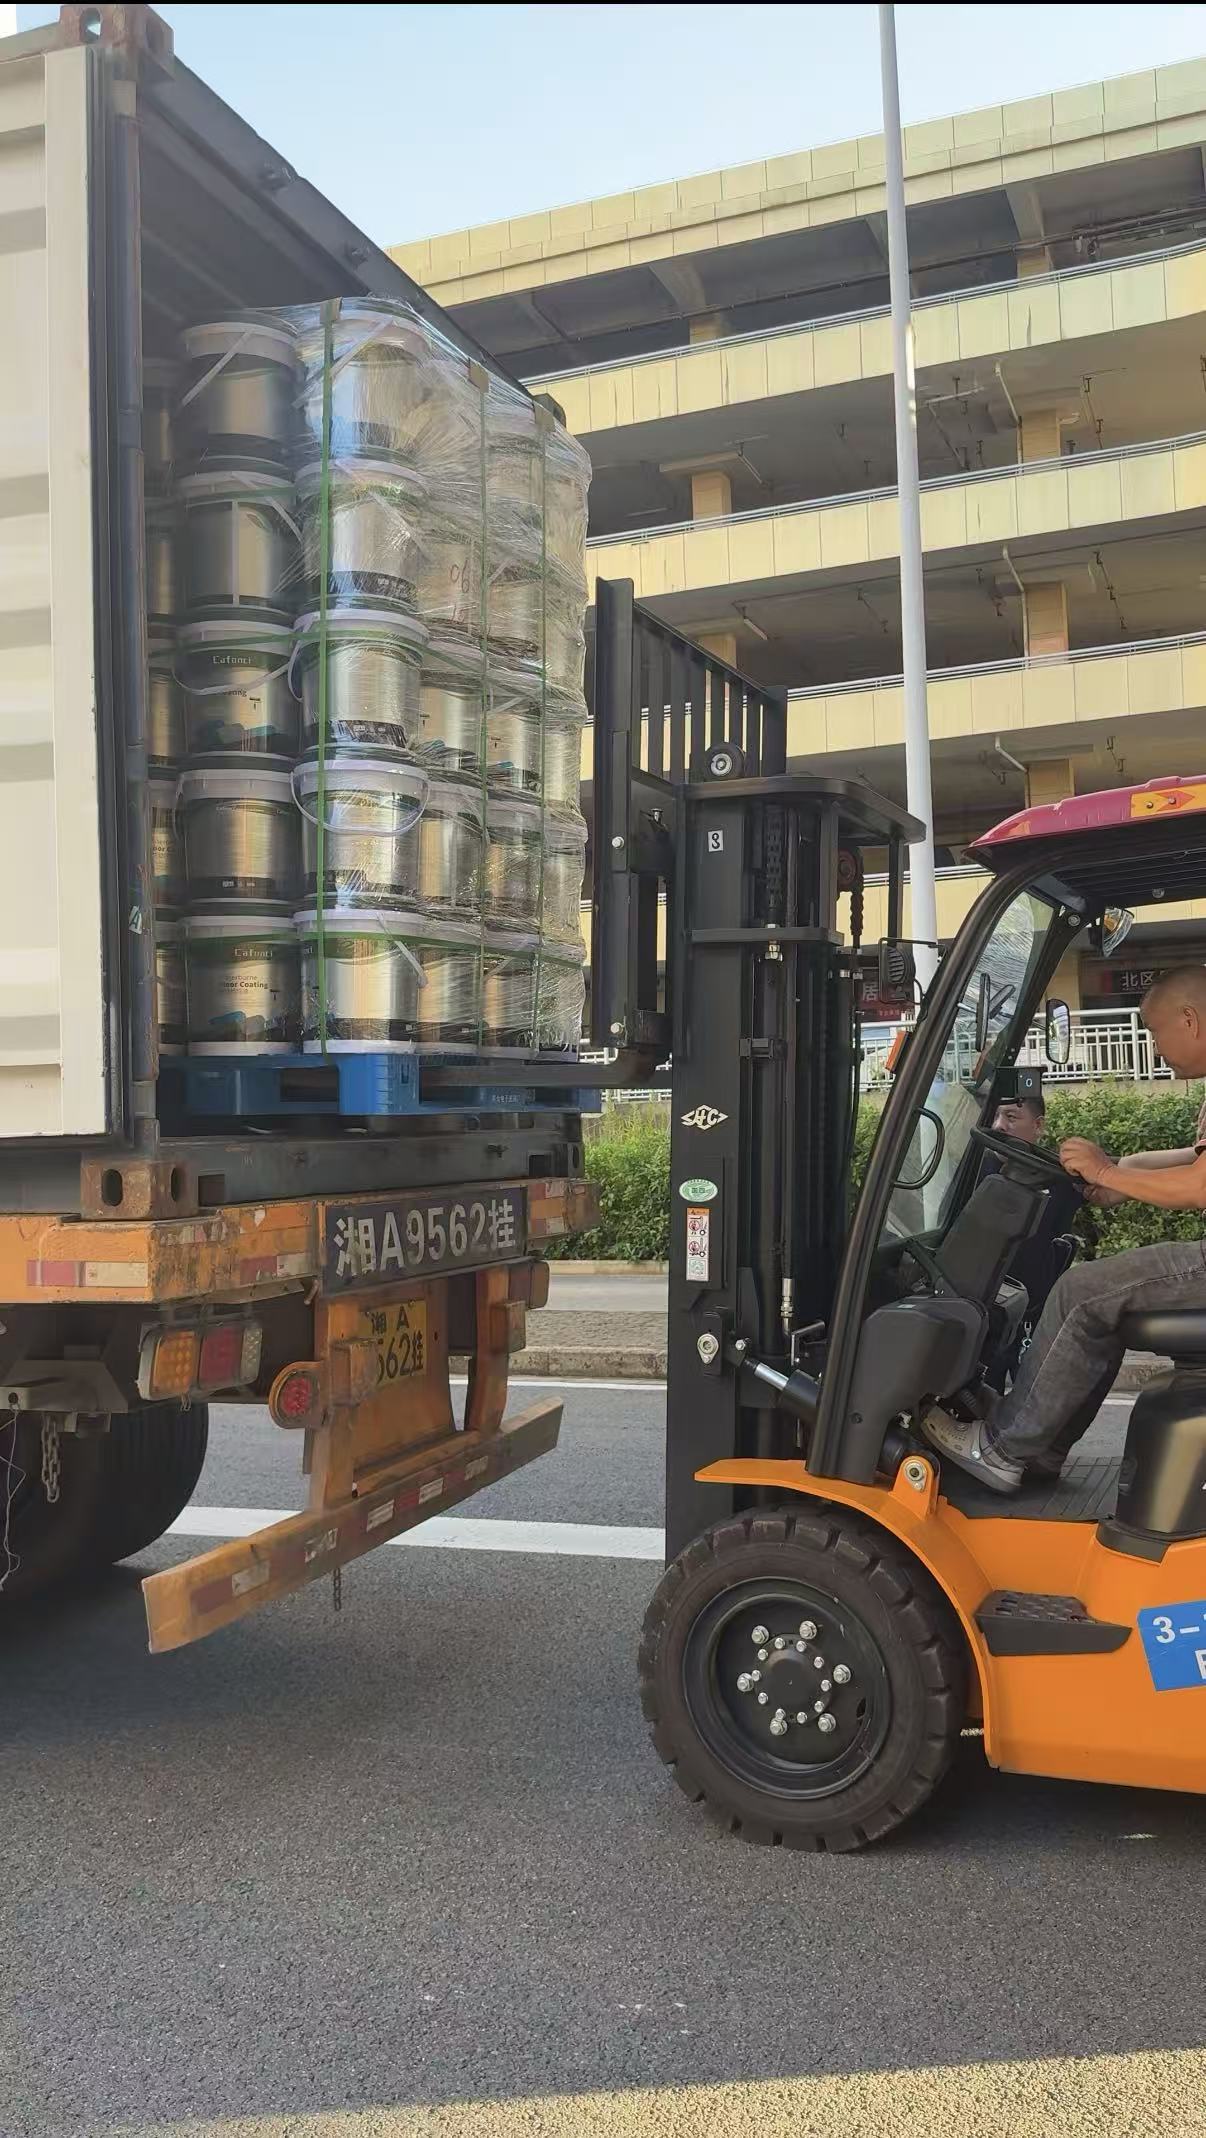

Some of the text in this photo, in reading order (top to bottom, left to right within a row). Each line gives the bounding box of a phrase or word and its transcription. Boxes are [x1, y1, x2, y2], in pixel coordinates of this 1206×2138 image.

[239, 981, 269, 990] Coating
[1121, 968, 1168, 988] 北区
[333, 1199, 516, 1277] 湘A9562挂
[375, 1330, 424, 1385] 62挂
[1152, 1612, 1206, 1644] 3-
